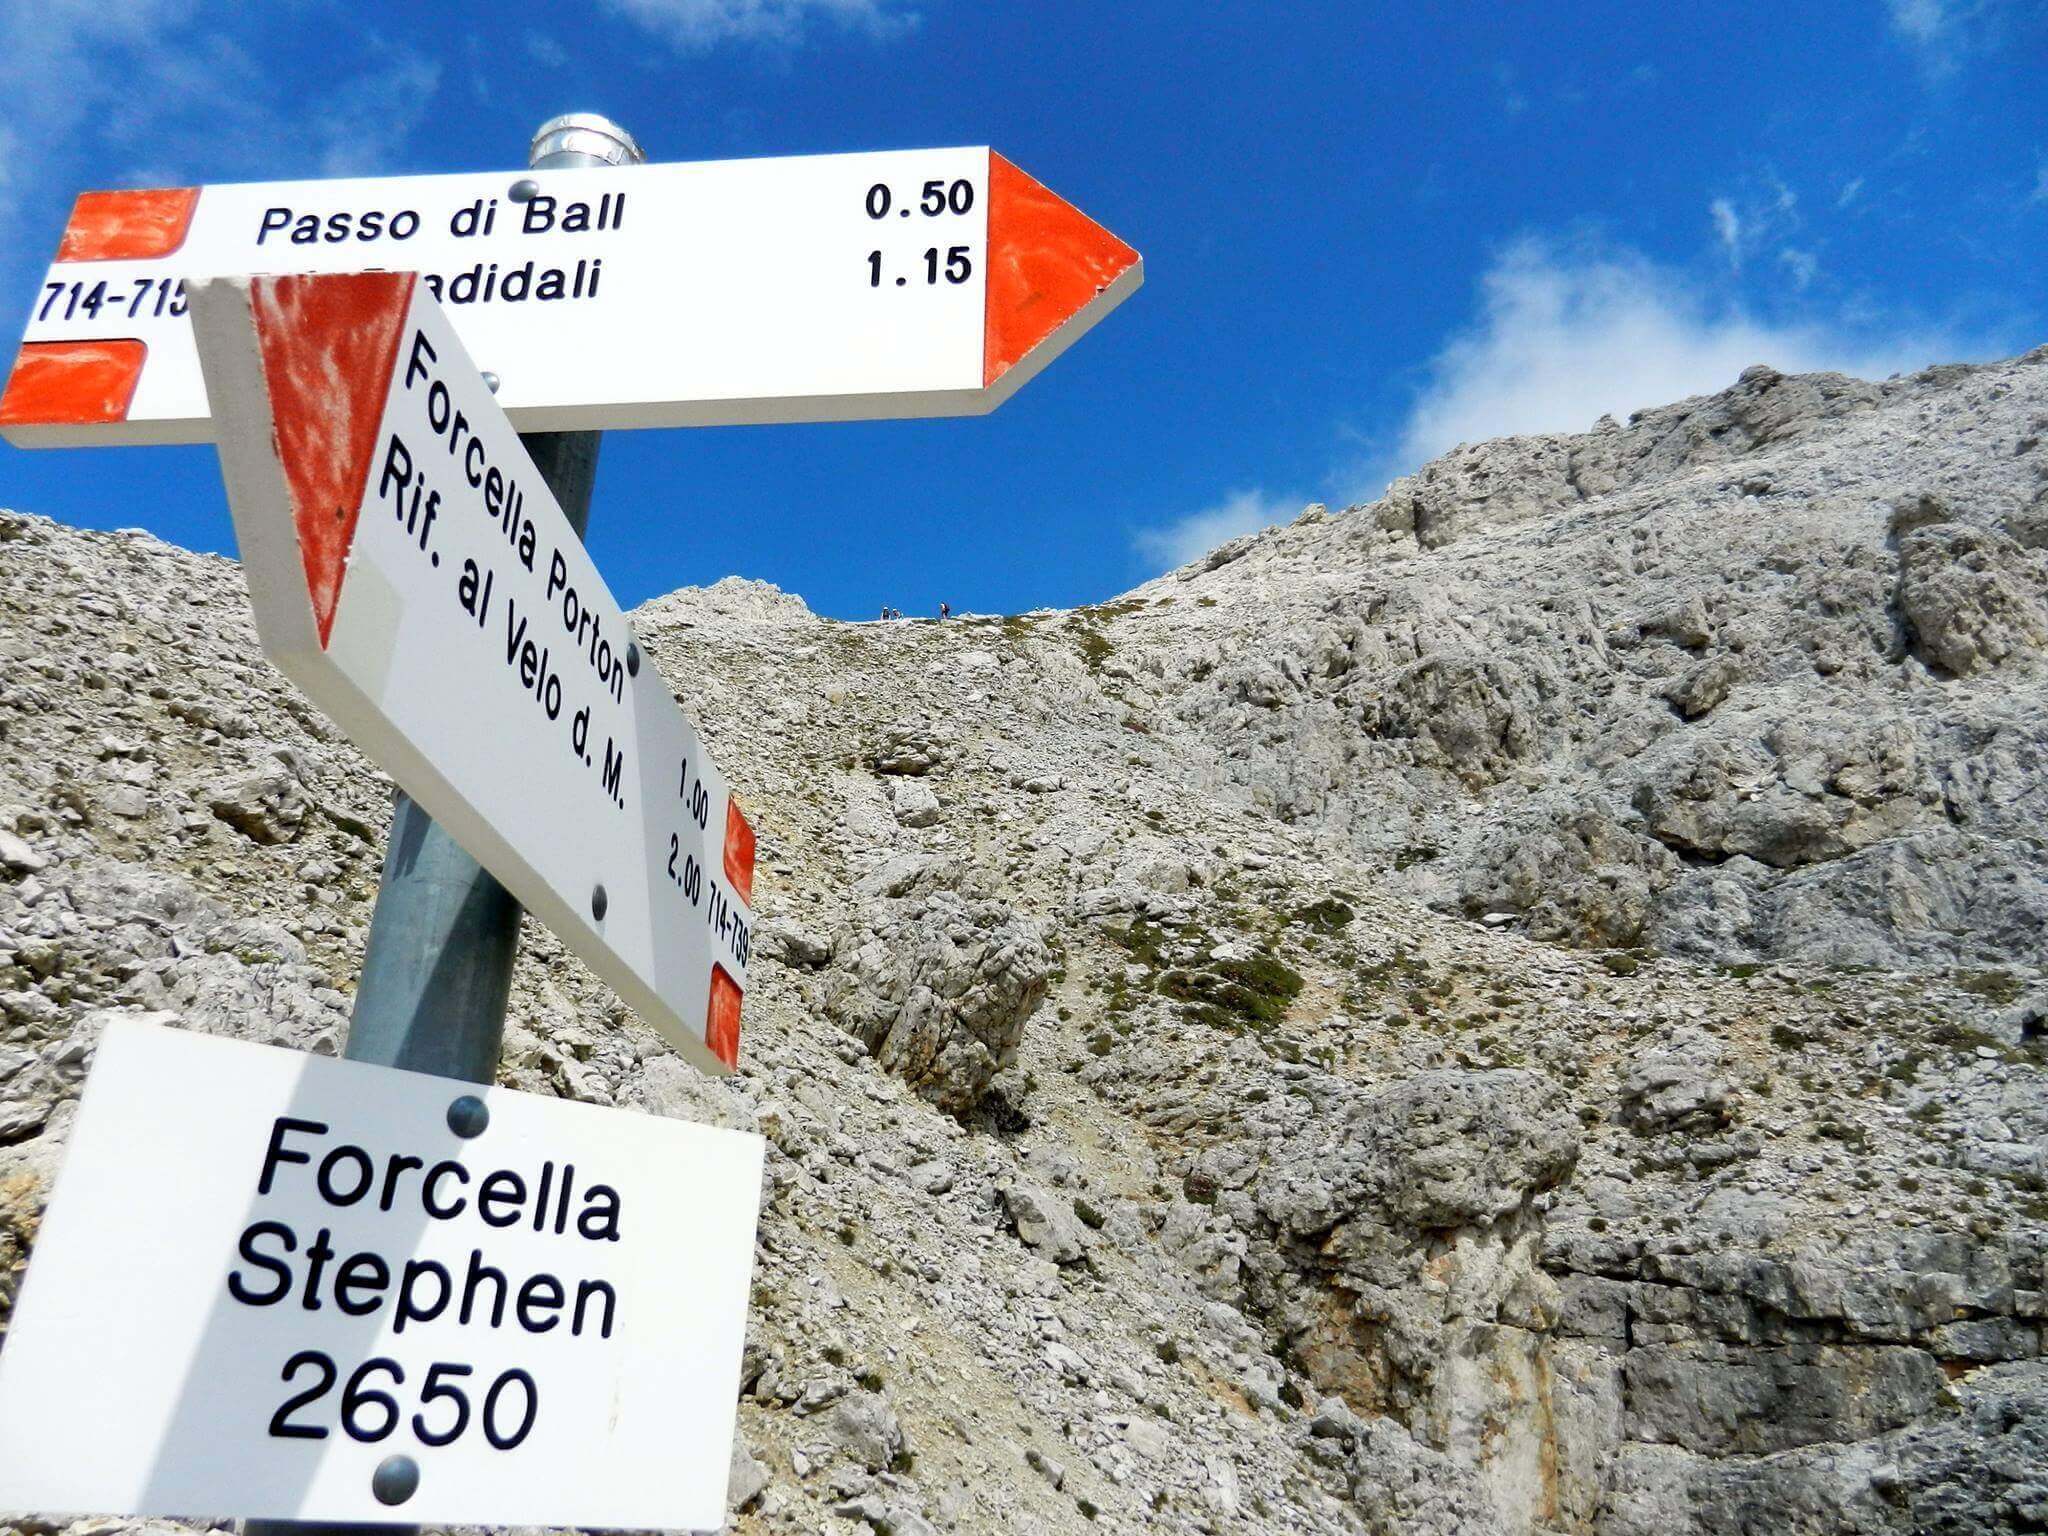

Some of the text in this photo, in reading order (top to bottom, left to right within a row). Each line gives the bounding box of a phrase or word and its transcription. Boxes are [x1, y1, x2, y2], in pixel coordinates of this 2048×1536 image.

[256, 192, 626, 246] Passo di Ball
[865, 178, 974, 220] 0.50
[866, 245, 972, 287] 1.15
[405, 328, 625, 706] Forcella Porton
[379, 432, 625, 811] Rif. al Velo d. M.
[679, 756, 709, 832] 1.00
[667, 831, 702, 908] 2.00
[708, 878, 750, 970] 714-739
[257, 1116, 622, 1243] Forcella
[227, 1219, 618, 1340] Stephen
[267, 1349, 539, 1452] 2650
